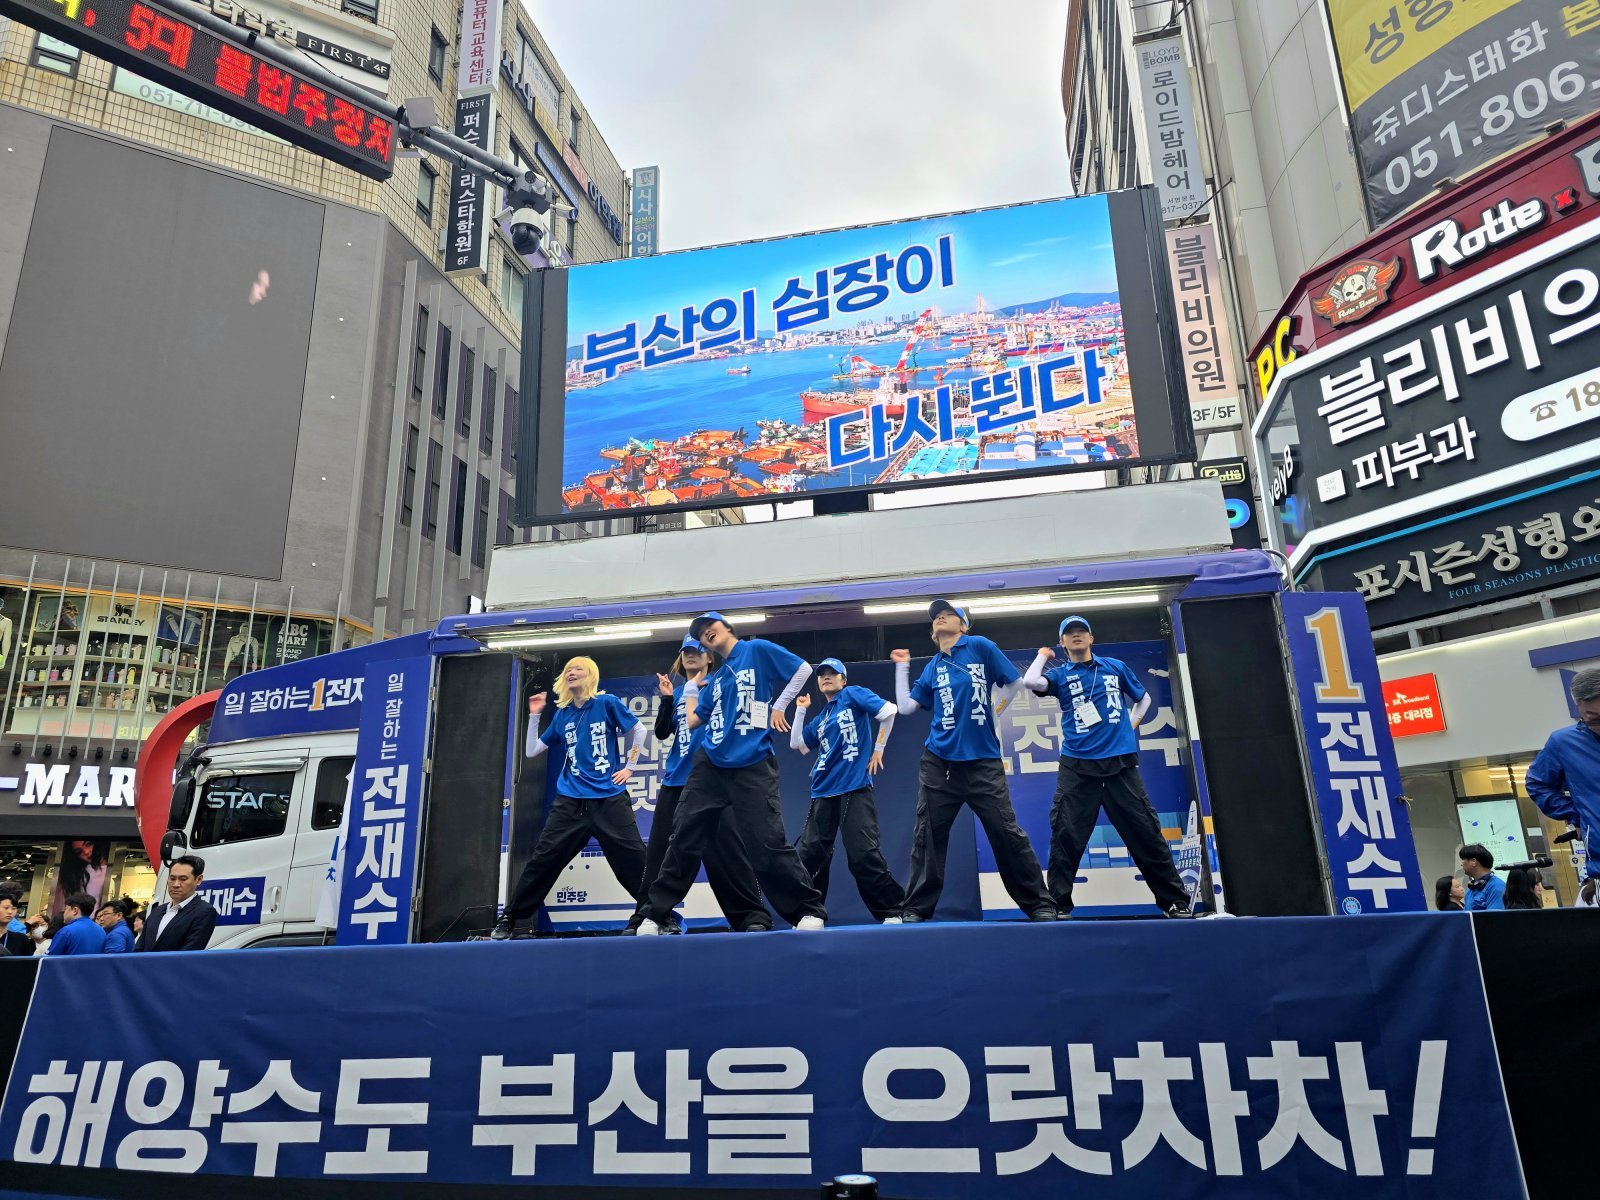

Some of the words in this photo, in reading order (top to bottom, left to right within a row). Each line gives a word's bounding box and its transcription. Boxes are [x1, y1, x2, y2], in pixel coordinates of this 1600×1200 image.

[124, 2, 193, 70] 5대
[307, 38, 368, 69] FIRST
[373, 62, 387, 74] 4F
[1149, 46, 1180, 59] LLOYD
[1150, 54, 1180, 66] BOMB
[461, 98, 486, 110] FIRST
[1152, 69, 1192, 191] 로이드밤헤어
[456, 111, 481, 254] 퍼스리스타학원
[457, 255, 469, 266] 6F
[1411, 199, 1544, 282] Rotte
[583, 287, 758, 379] 부산의
[772, 236, 955, 332] 심장이
[1172, 234, 1226, 393] 블리비의원
[828, 384, 955, 469] 다시
[969, 349, 1107, 433] 뛴다
[1193, 404, 1237, 421] 3F/5F
[1351, 415, 1476, 488] 피부과
[1448, 584, 1481, 600] FOUR
[1484, 569, 1542, 592] SEASONS
[224, 692, 246, 716] 일
[387, 672, 405, 693] 일
[735, 668, 755, 735] 전재수
[966, 663, 988, 726] 전재수
[1101, 674, 1122, 725] 전재수
[380, 698, 404, 761] 잘하는
[1403, 706, 1434, 721] 대리점
[590, 721, 610, 774] 전재수
[350, 764, 409, 941] 전재수
[556, 890, 588, 904] 민주당
[13, 1056, 432, 1178] 해양수도
[471, 1045, 815, 1176] 부산을
[861, 1039, 1448, 1177] 으랏차차!
